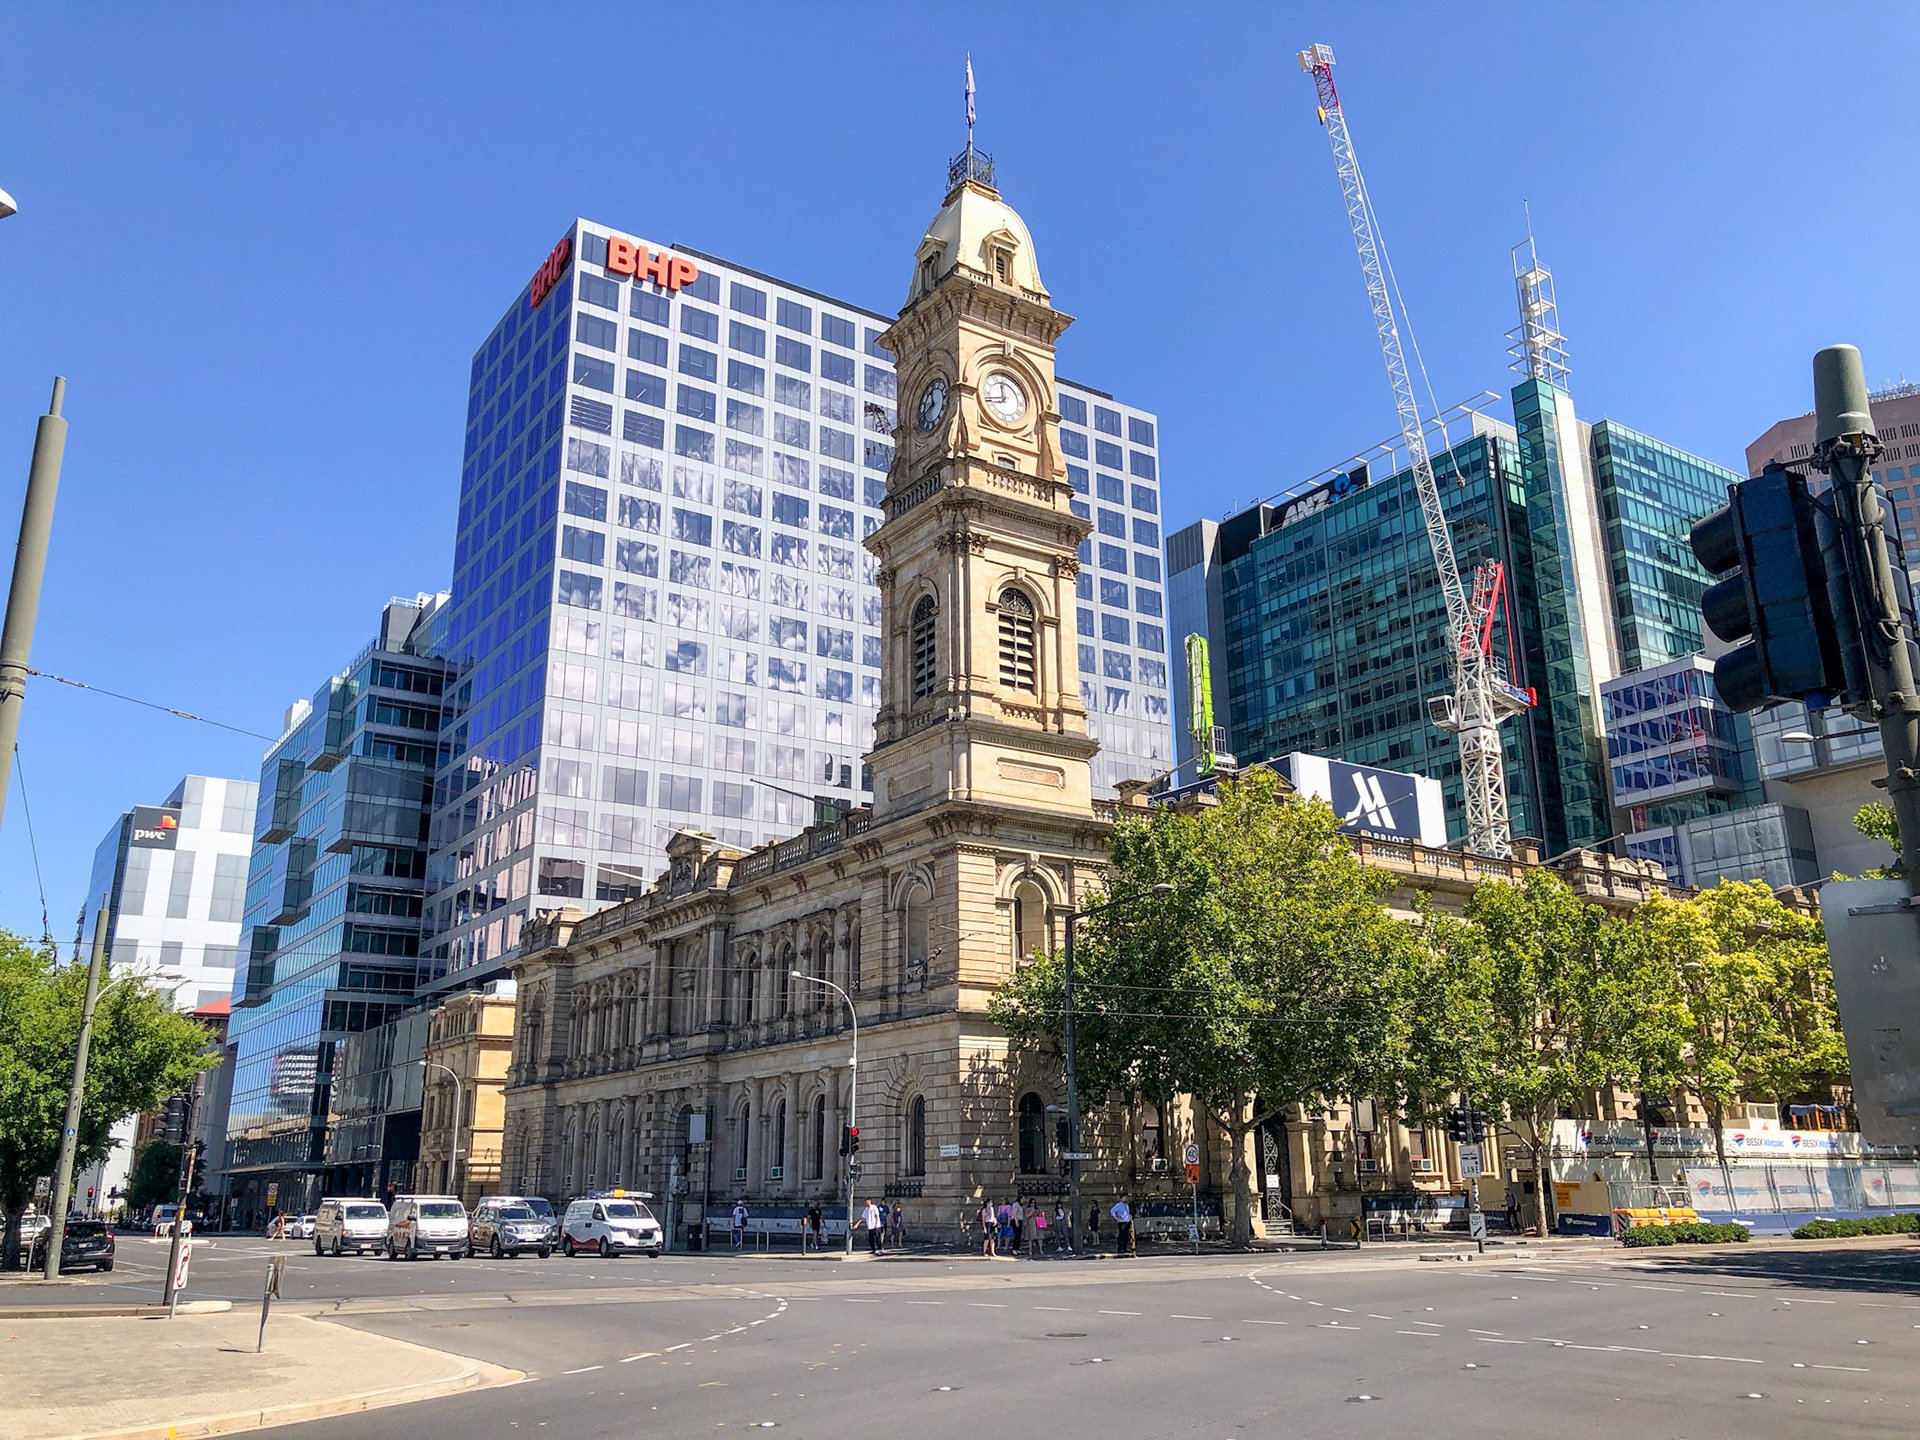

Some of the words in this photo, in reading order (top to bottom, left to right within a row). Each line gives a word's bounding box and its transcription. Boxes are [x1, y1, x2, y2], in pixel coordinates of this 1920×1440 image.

[530, 237, 573, 309] BHP
[606, 235, 699, 291] BHP
[1281, 488, 1330, 529] ANZ
[133, 829, 166, 840] pwc
[1188, 1148, 1196, 1157] 40
[1463, 1165, 1479, 1174] LANE
